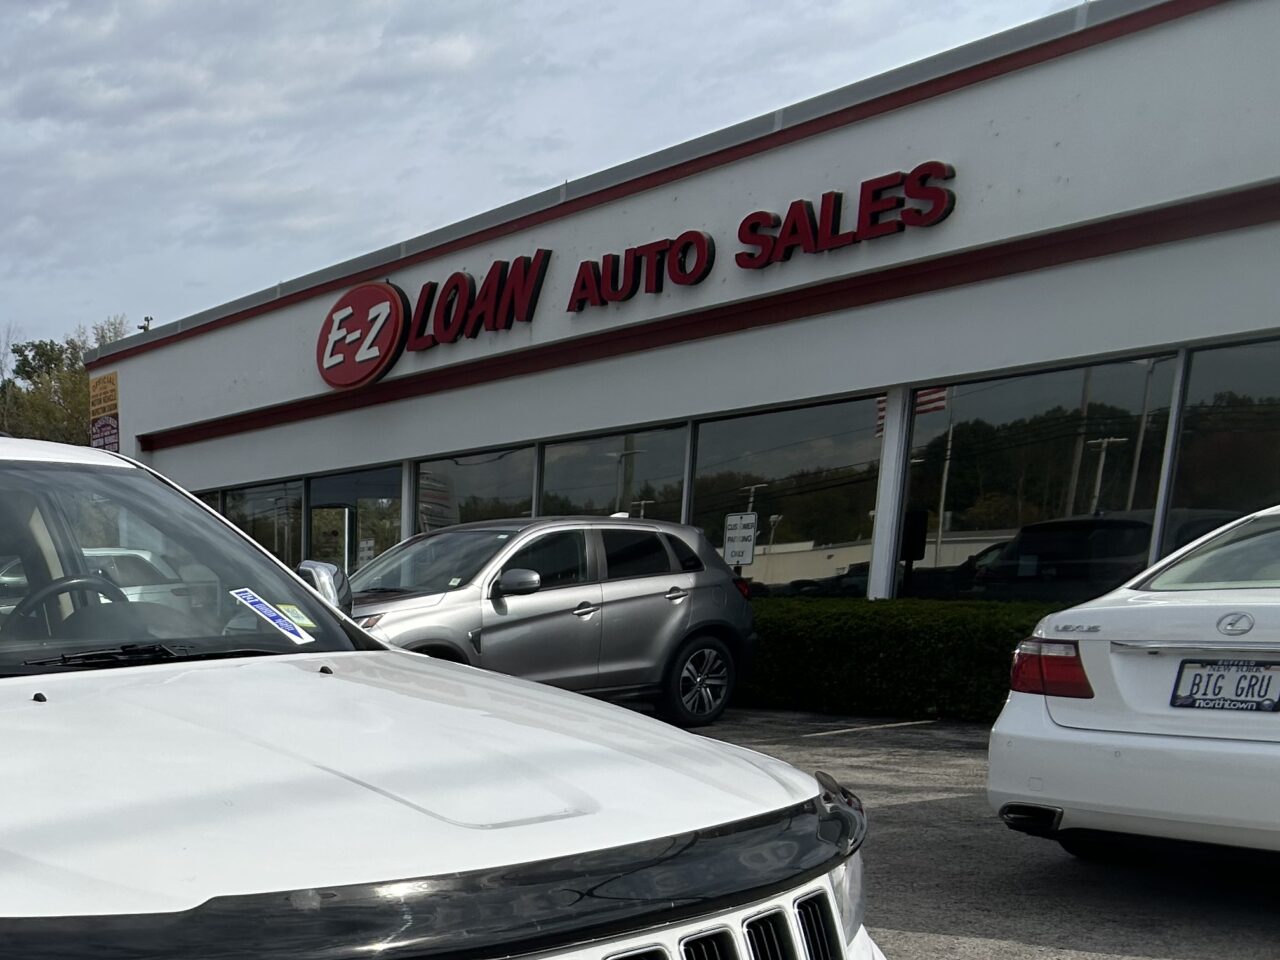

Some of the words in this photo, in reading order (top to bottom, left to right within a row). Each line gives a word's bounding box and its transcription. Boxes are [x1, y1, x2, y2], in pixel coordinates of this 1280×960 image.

[322, 300, 392, 370] E-Z
[406, 248, 553, 352] LOAN
[566, 230, 715, 313] AUTO
[734, 160, 957, 270] SALES
[1209, 665, 1231, 673] NEW
[1189, 673, 1225, 697] BIG
[1235, 674, 1273, 699] GRU
[1195, 697, 1257, 710] northtown
